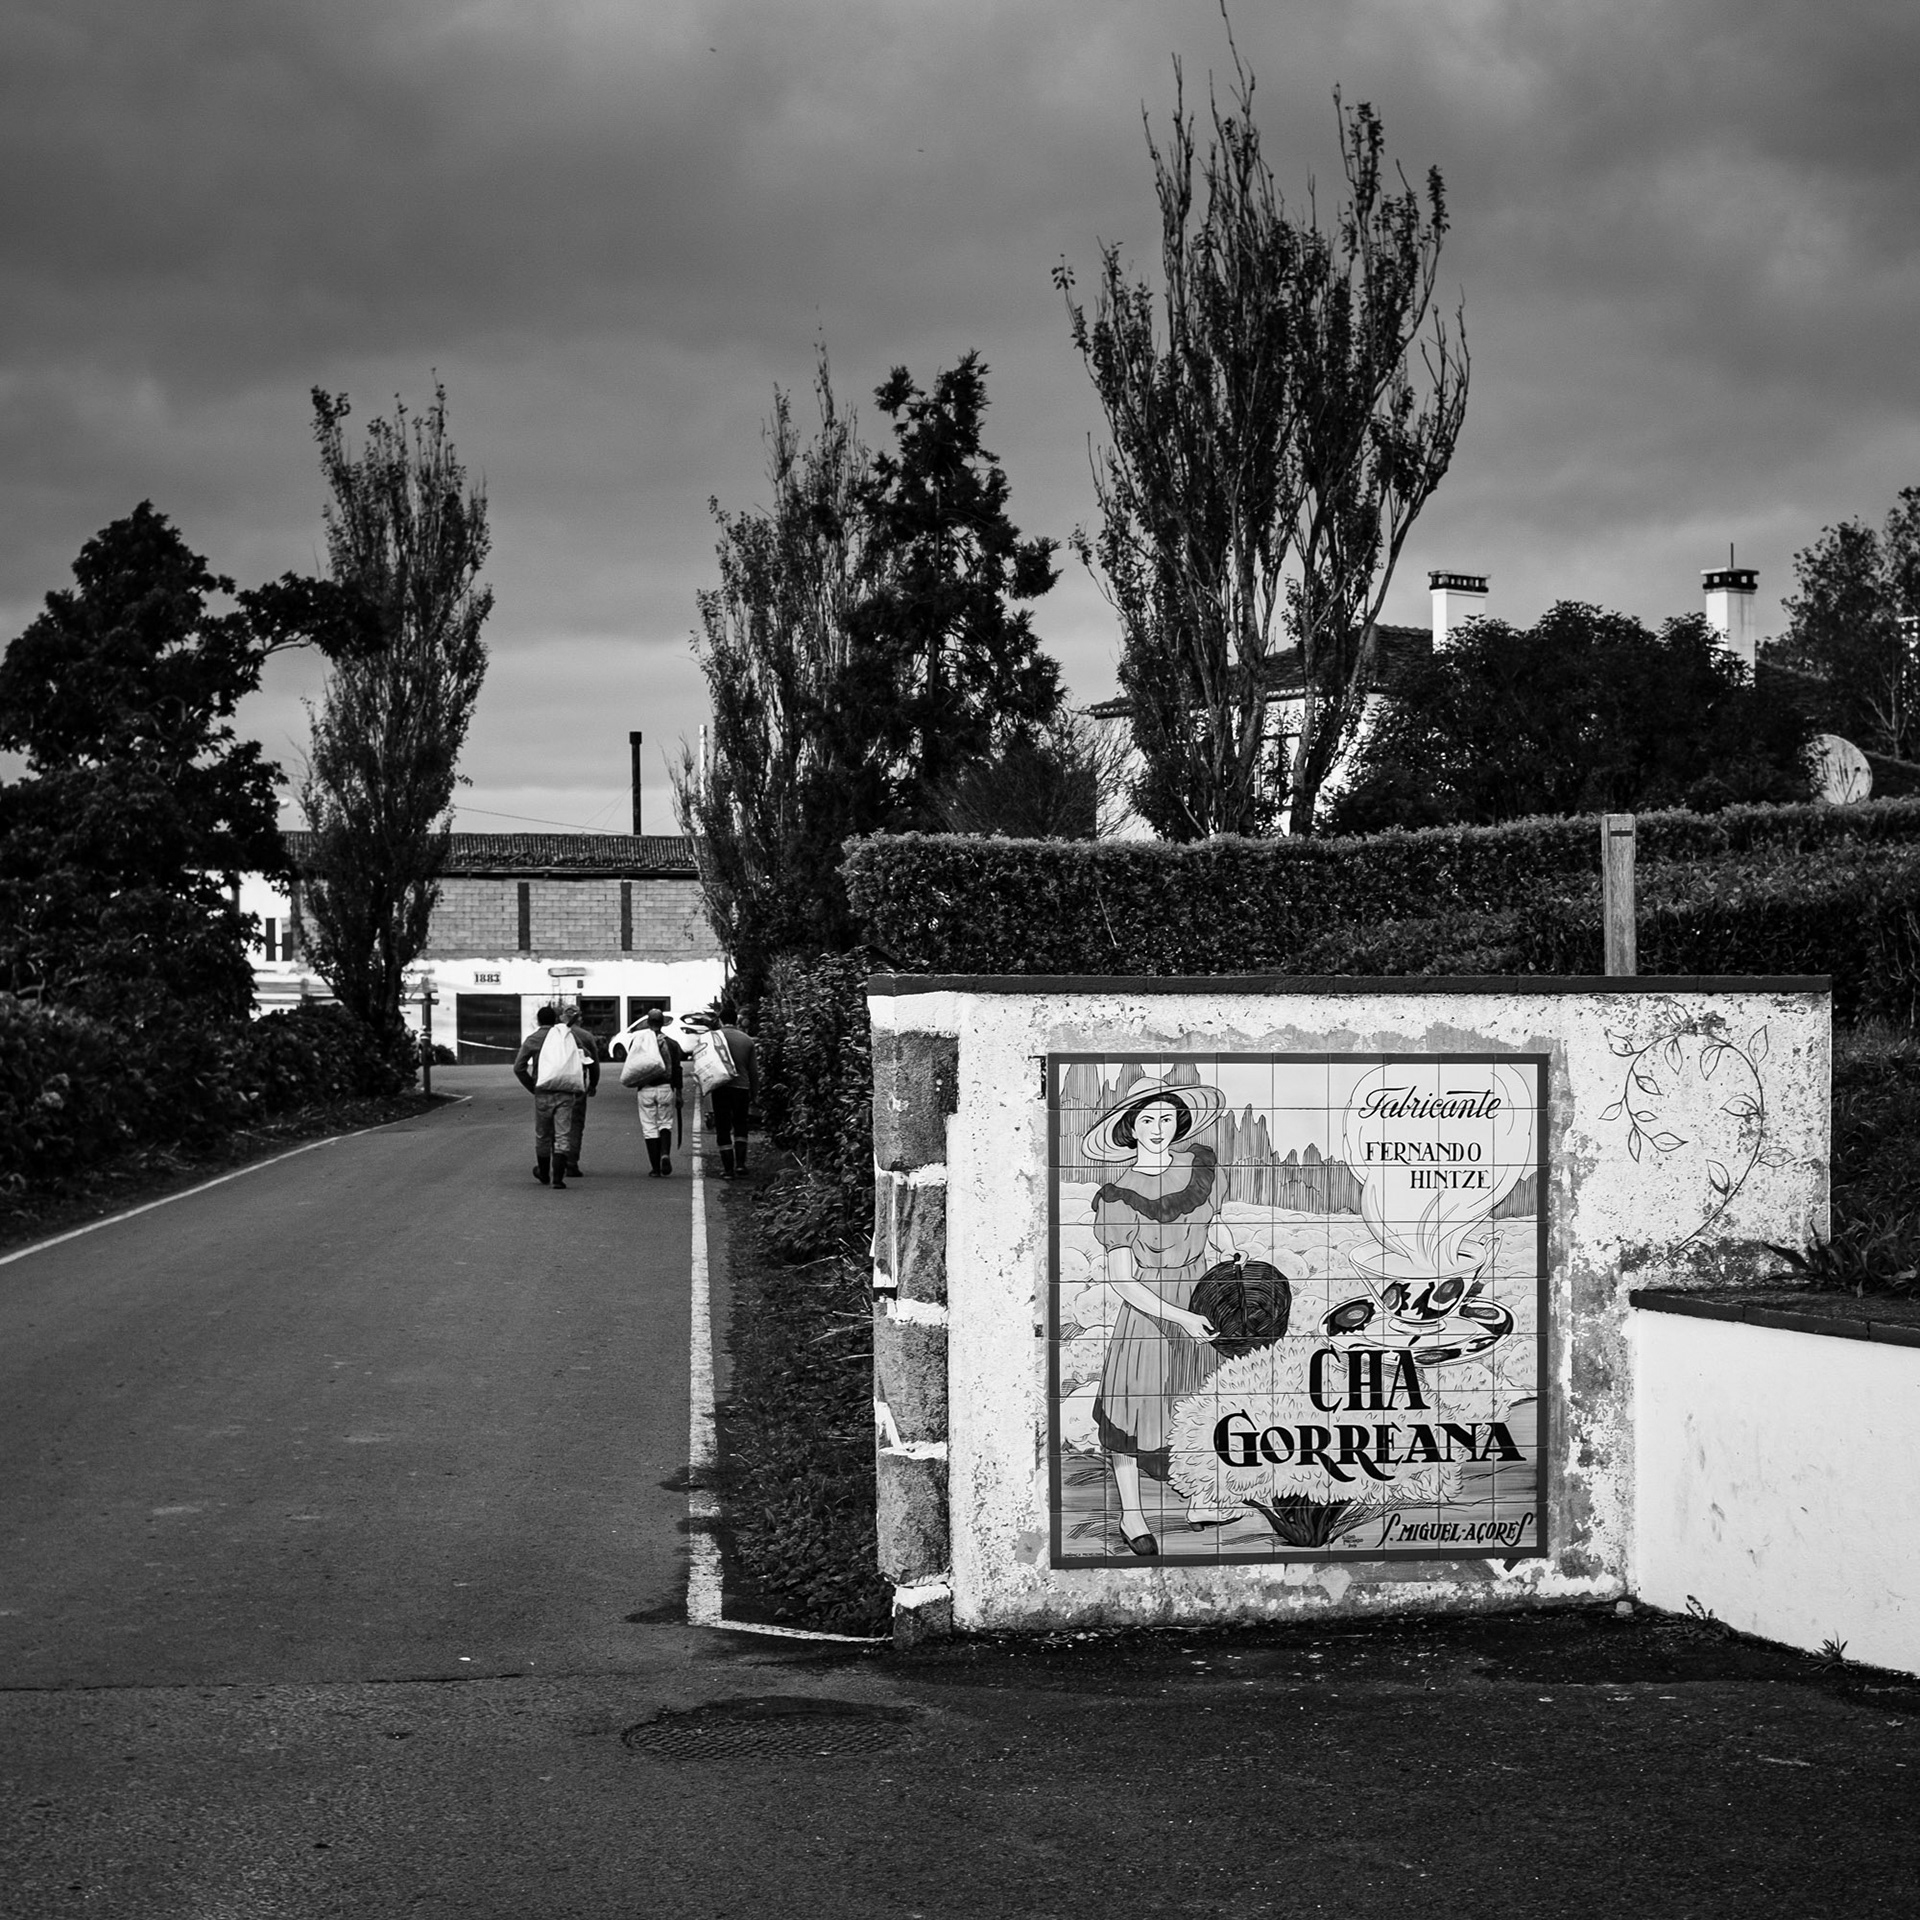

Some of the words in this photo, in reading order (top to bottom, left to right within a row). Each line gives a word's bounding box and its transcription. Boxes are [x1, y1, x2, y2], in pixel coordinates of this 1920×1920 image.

[475, 973, 499, 983] 1883
[1358, 1086, 1501, 1119] Fabricante
[1365, 1142, 1481, 1165] FERNANDO
[1410, 1170, 1491, 1190] HINTZE
